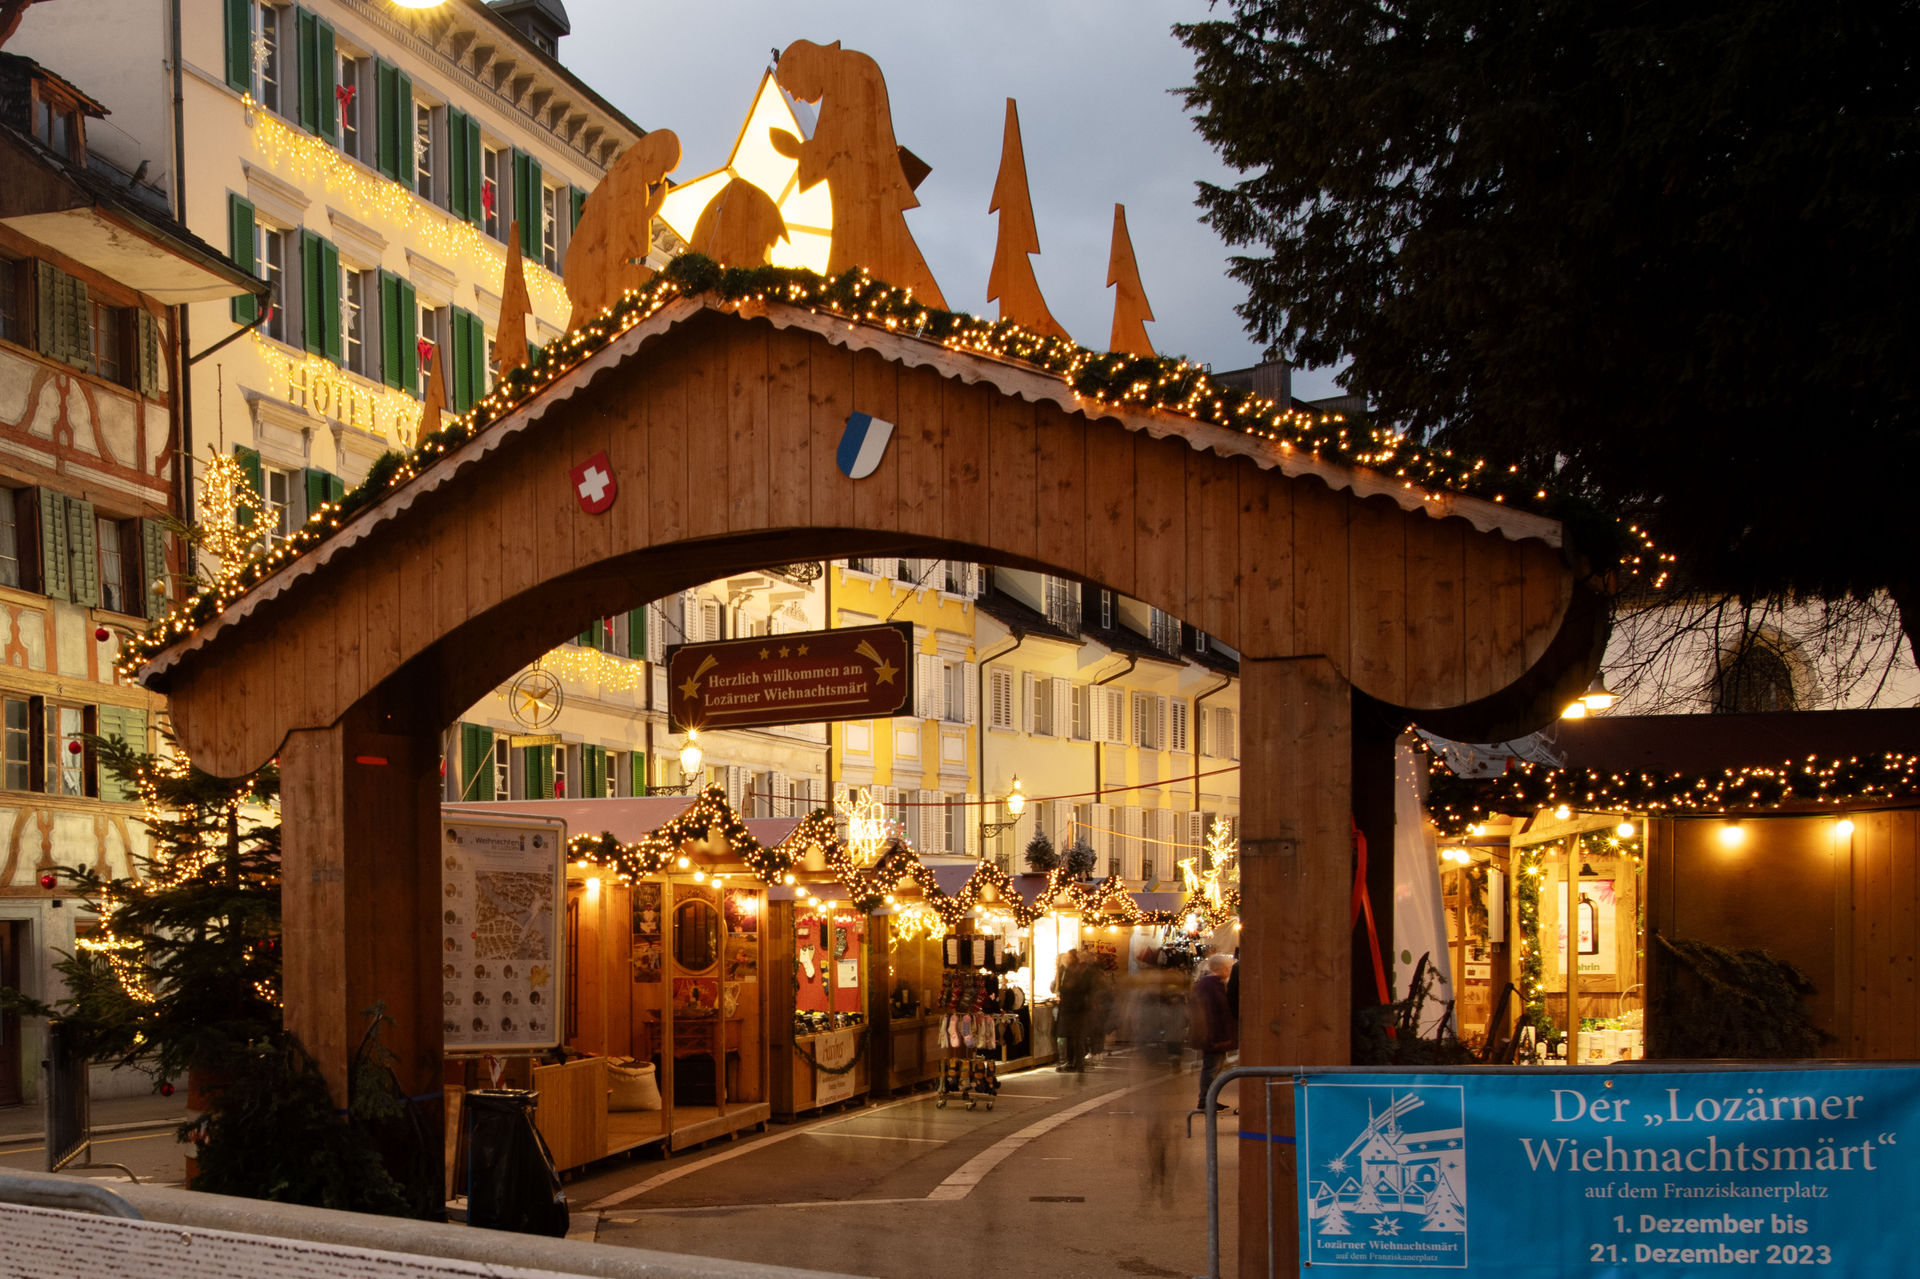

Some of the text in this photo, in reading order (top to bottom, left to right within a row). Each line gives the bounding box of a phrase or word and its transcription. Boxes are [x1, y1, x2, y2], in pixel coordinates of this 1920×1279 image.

[288, 362, 387, 439] HOTEL
[708, 664, 863, 689] Herzlich willkommen am
[704, 681, 868, 707] Lozärner Wiehnachtsmärt
[1551, 1087, 1865, 1127] Der „Lozärner
[1518, 1131, 1897, 1173] Wiehnachtsmärt“
[1585, 1180, 1829, 1203] auf dem Franziskanerplatz
[1613, 1213, 1809, 1235] 1. Dezember bis
[1317, 1239, 1458, 1252] Lozärner Wiehnachtsmärt
[1335, 1252, 1439, 1263] auf dem Franziskanerplatz
[1589, 1243, 1833, 1265] 21. Dezember 2023
